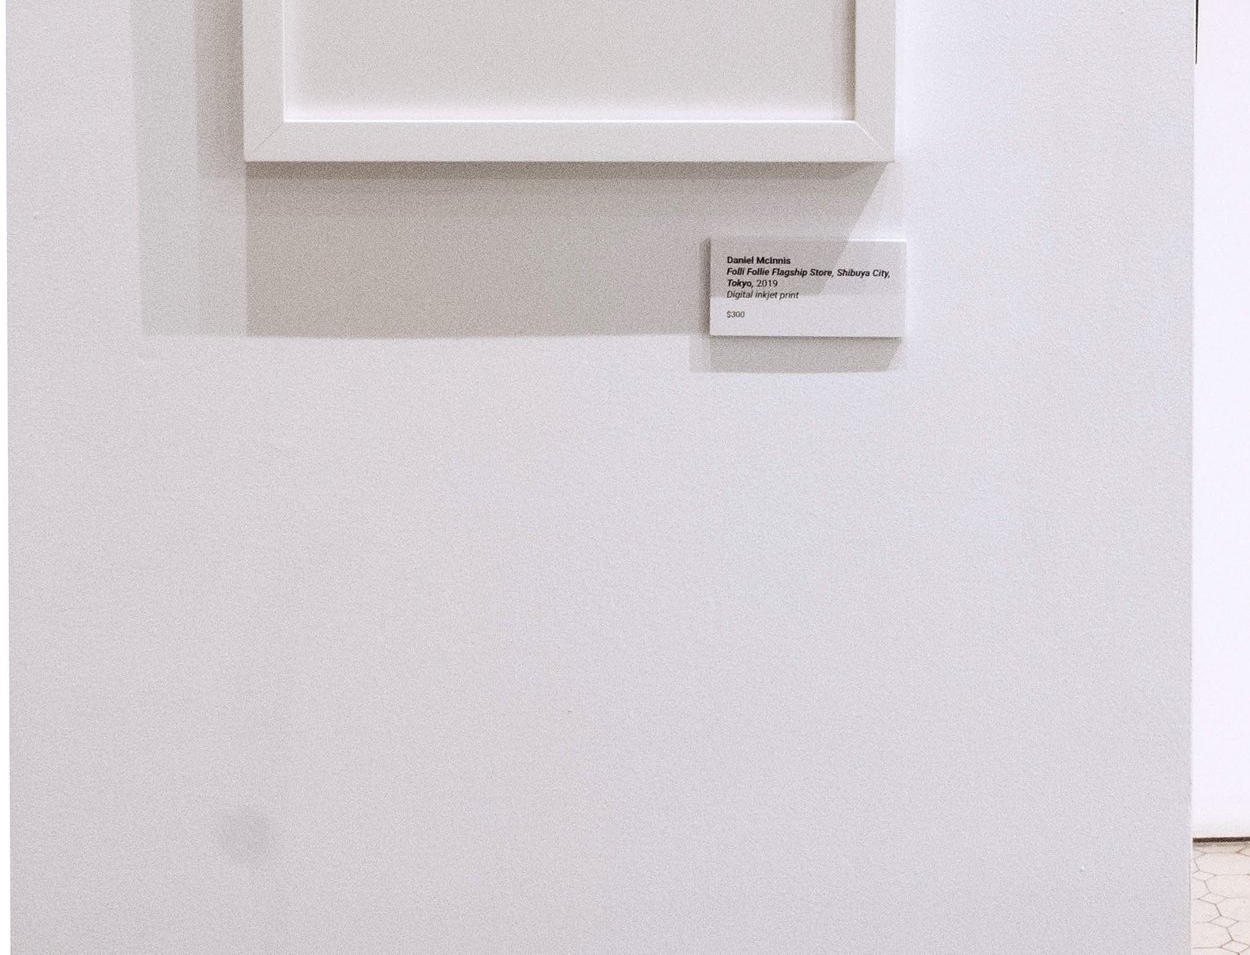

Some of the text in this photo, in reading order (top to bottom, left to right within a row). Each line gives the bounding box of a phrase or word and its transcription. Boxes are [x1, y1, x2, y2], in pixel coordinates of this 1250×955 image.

[726, 255, 792, 265] Daniel McInnis
[726, 267, 891, 279] Folli Follie Flagship Store, Shibuya City,
[727, 278, 779, 289] Tokyo, 2019
[726, 290, 800, 301] Digital inkjet print
[726, 310, 746, 319] $300
